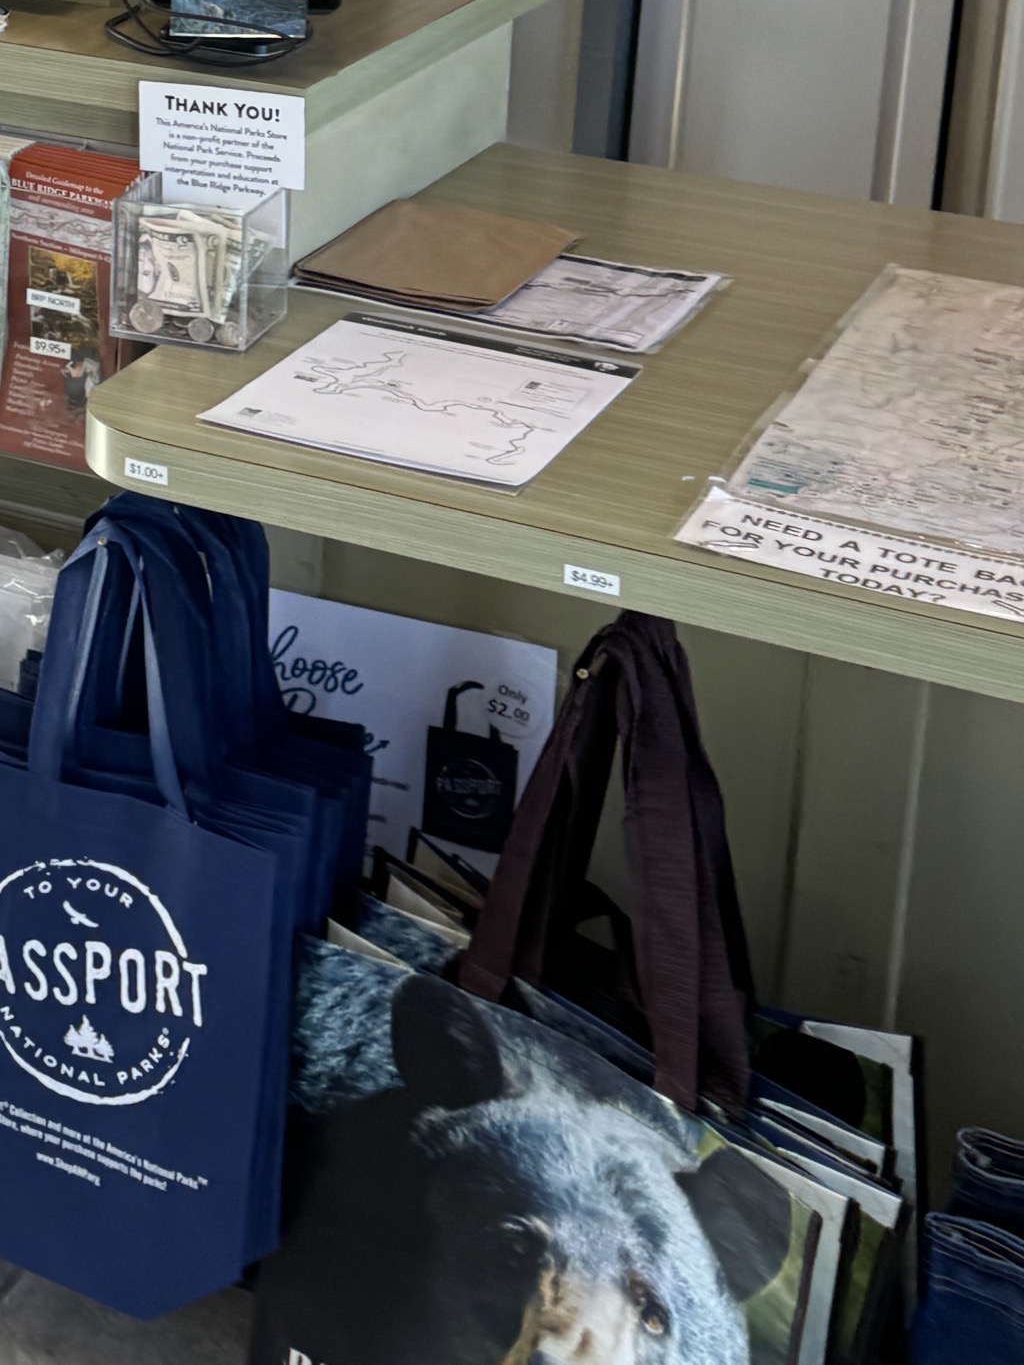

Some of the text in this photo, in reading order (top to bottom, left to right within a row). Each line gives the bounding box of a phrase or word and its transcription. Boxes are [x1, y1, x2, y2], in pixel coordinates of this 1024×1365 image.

[165, 95, 281, 122] THANK YOU!
[156, 117, 287, 140] This America's National Parks Store
[163, 141, 281, 162] National Park Service. Proceeds
[182, 133, 221, 144] non-profit
[222, 139, 250, 148] partner
[252, 140, 260, 148] of
[261, 141, 274, 150] the
[164, 165, 216, 178] interpretation
[217, 171, 231, 179] and
[233, 174, 269, 184] education
[170, 154, 272, 174] from your purchase support
[177, 177, 267, 196] the Blue Ridge Parkway.
[30, 292, 76, 309] BRP NORTH
[35, 341, 67, 356] $9.95+
[129, 463, 164, 478] $1.00+
[741, 514, 824, 542] NEED
[839, 540, 861, 553] A
[878, 547, 959, 574] TOTE
[702, 520, 1024, 603] FOR YOUR PURCHAS
[570, 570, 614, 588] $4.99+
[819, 568, 947, 603] TODAY?
[269, 626, 364, 695] hoose
[497, 684, 528, 704] Only
[24, 877, 134, 909] TO YOUR
[0, 1005, 172, 1087] NATIONAL PARKS
[9, 1104, 47, 1127] Collection
[47, 1119, 62, 1133] and
[92, 1137, 106, 1150] the
[106, 1143, 142, 1167] America's
[143, 1159, 176, 1181] National
[44, 1133, 61, 1146] your
[62, 1140, 96, 1160] purchase
[96, 1153, 129, 1175] supports
[129, 1166, 142, 1181] the
